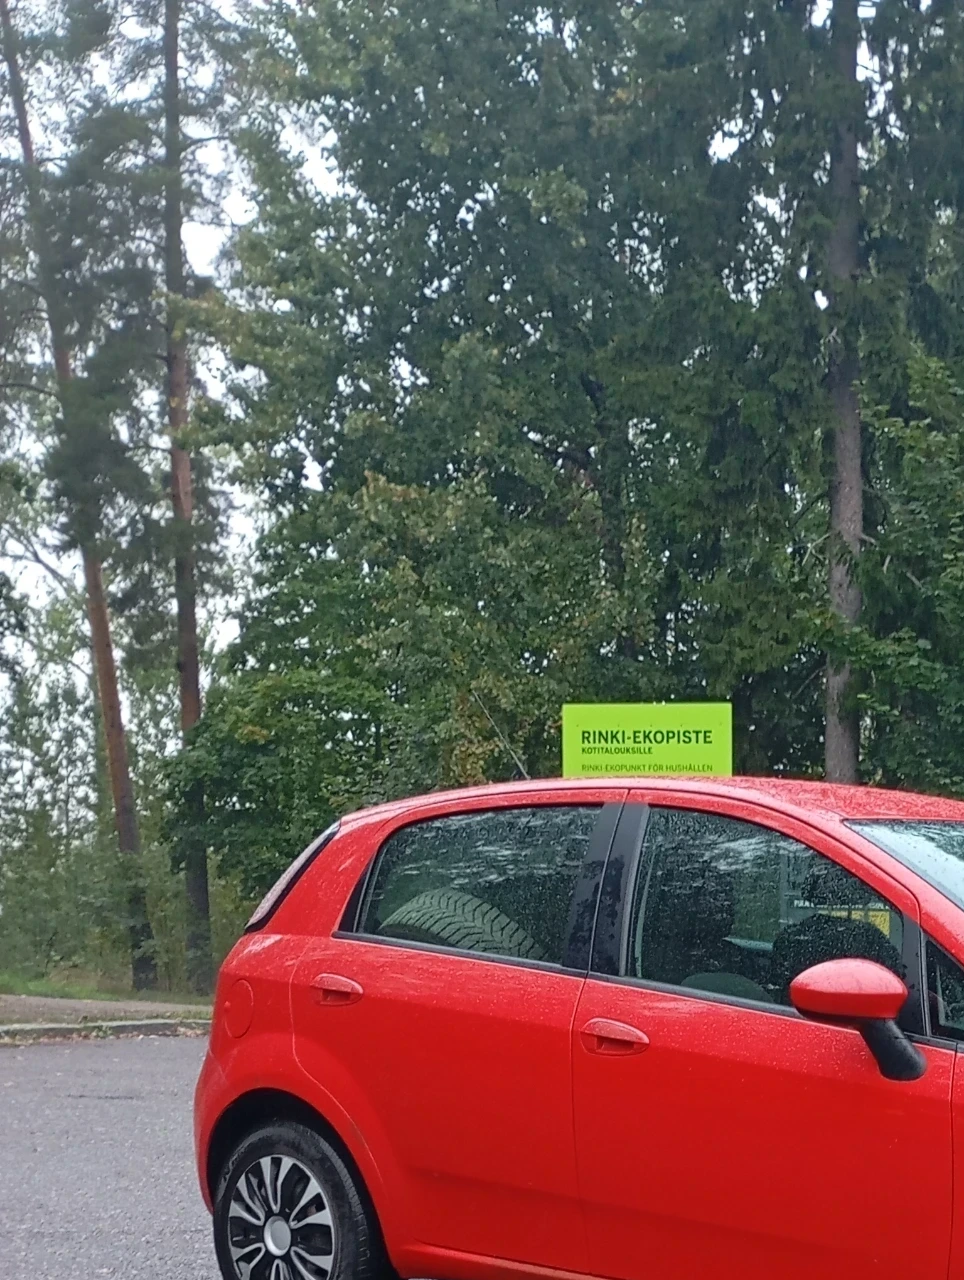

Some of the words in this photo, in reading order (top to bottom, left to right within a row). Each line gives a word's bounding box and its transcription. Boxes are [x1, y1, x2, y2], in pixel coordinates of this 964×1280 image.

[581, 730, 713, 744] RINKI-EKOPISTE
[581, 747, 653, 755] KOTITALOUKSILLE
[581, 764, 646, 772] RINKI-EKOPUNKT
[648, 763, 664, 772] FÖR
[665, 763, 713, 772] HUSHÅLLEN
